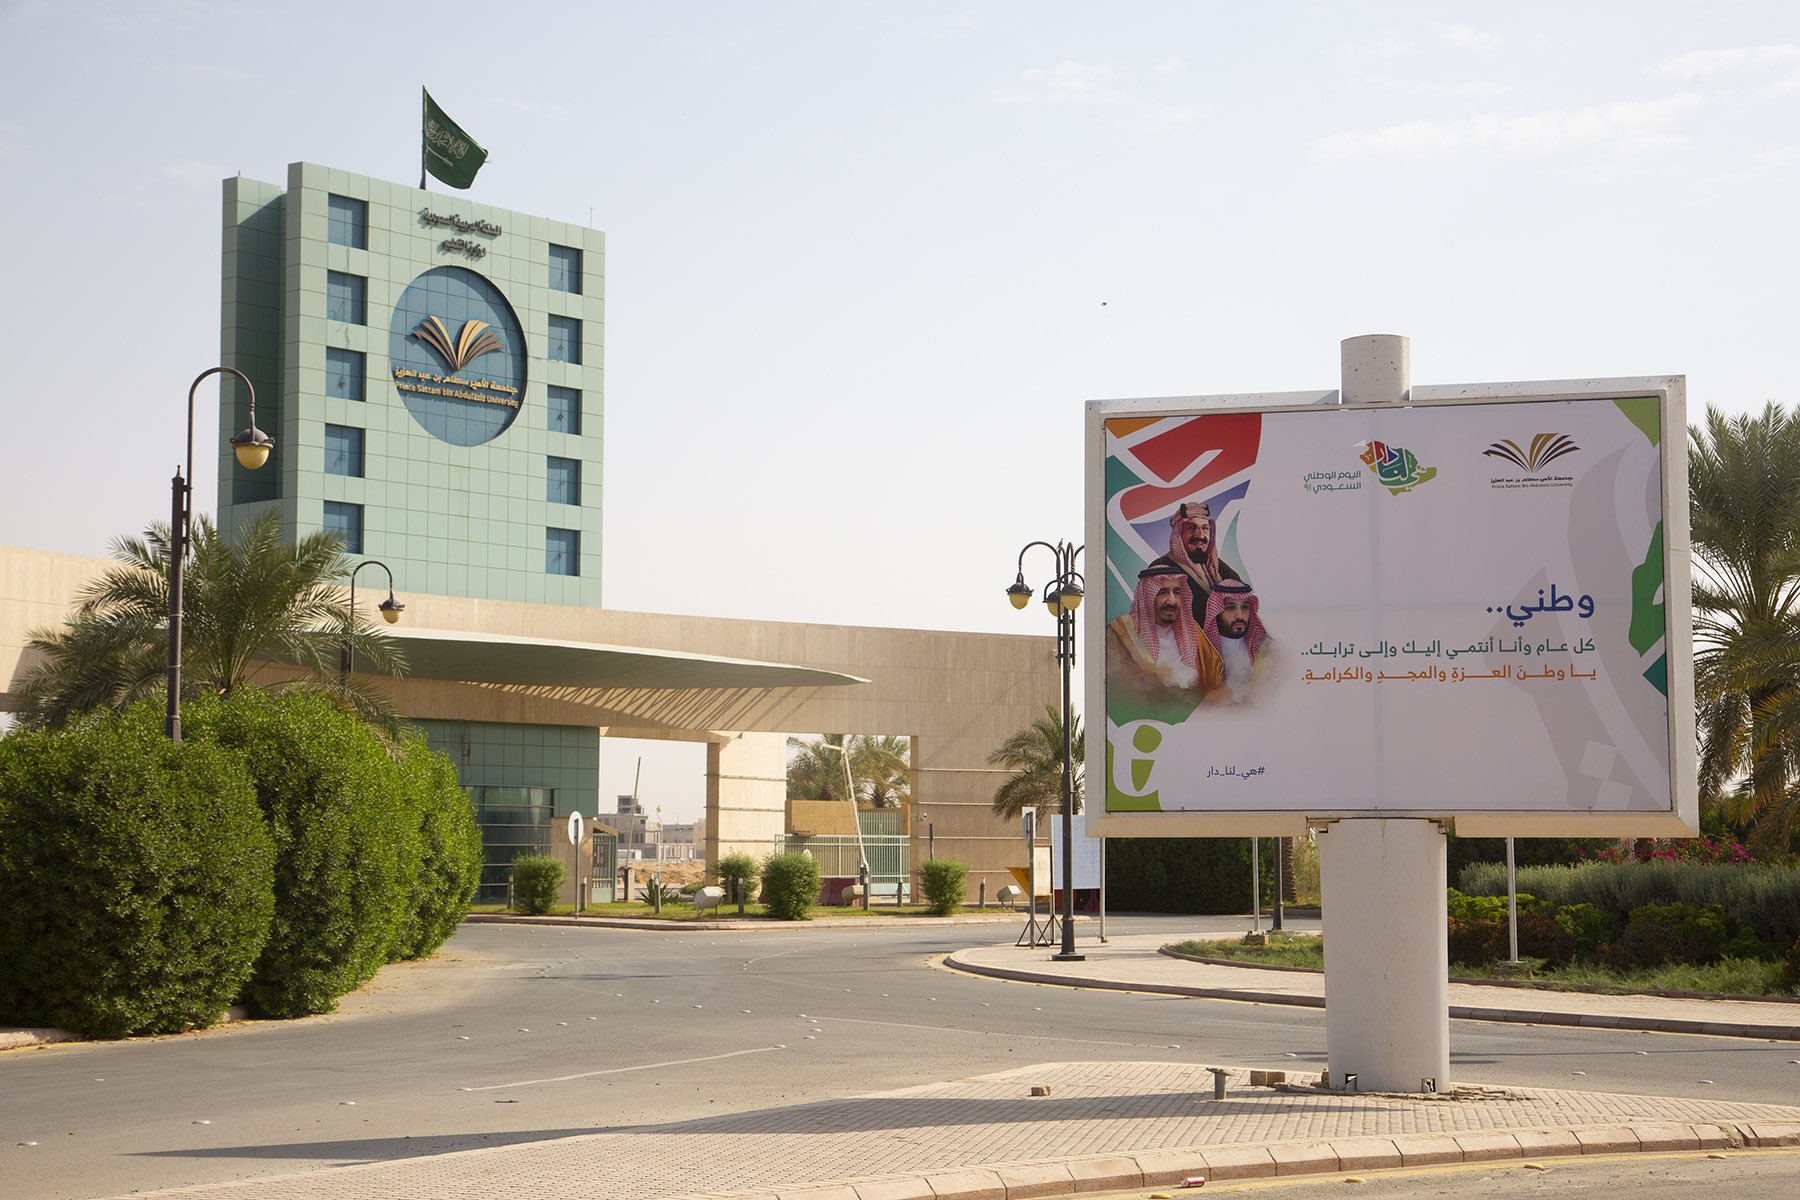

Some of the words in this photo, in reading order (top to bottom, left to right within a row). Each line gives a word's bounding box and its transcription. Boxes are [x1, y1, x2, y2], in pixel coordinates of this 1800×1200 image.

[418, 372, 432, 381] عبد
[443, 375, 469, 385] سطام
[395, 381, 417, 391] Prince
[417, 384, 442, 395] Sattam
[454, 390, 486, 403] Abdulaziz
[486, 396, 519, 408] University
[490, 381, 519, 396] جامعة
[1303, 471, 1337, 482] الوطني
[1337, 470, 1362, 480] اليوم
[1312, 481, 1362, 495] السعودي
[1486, 584, 1595, 627] وطني..
[1301, 641, 1355, 658] ترابك..
[1359, 640, 1398, 658] وإلى
[1402, 640, 1441, 658] إليك
[1445, 636, 1494, 660] أنتمي
[1499, 636, 1532, 655] وأنا
[1536, 638, 1569, 656] عام
[1573, 638, 1596, 654] كل
[1570, 664, 1597, 680] يا
